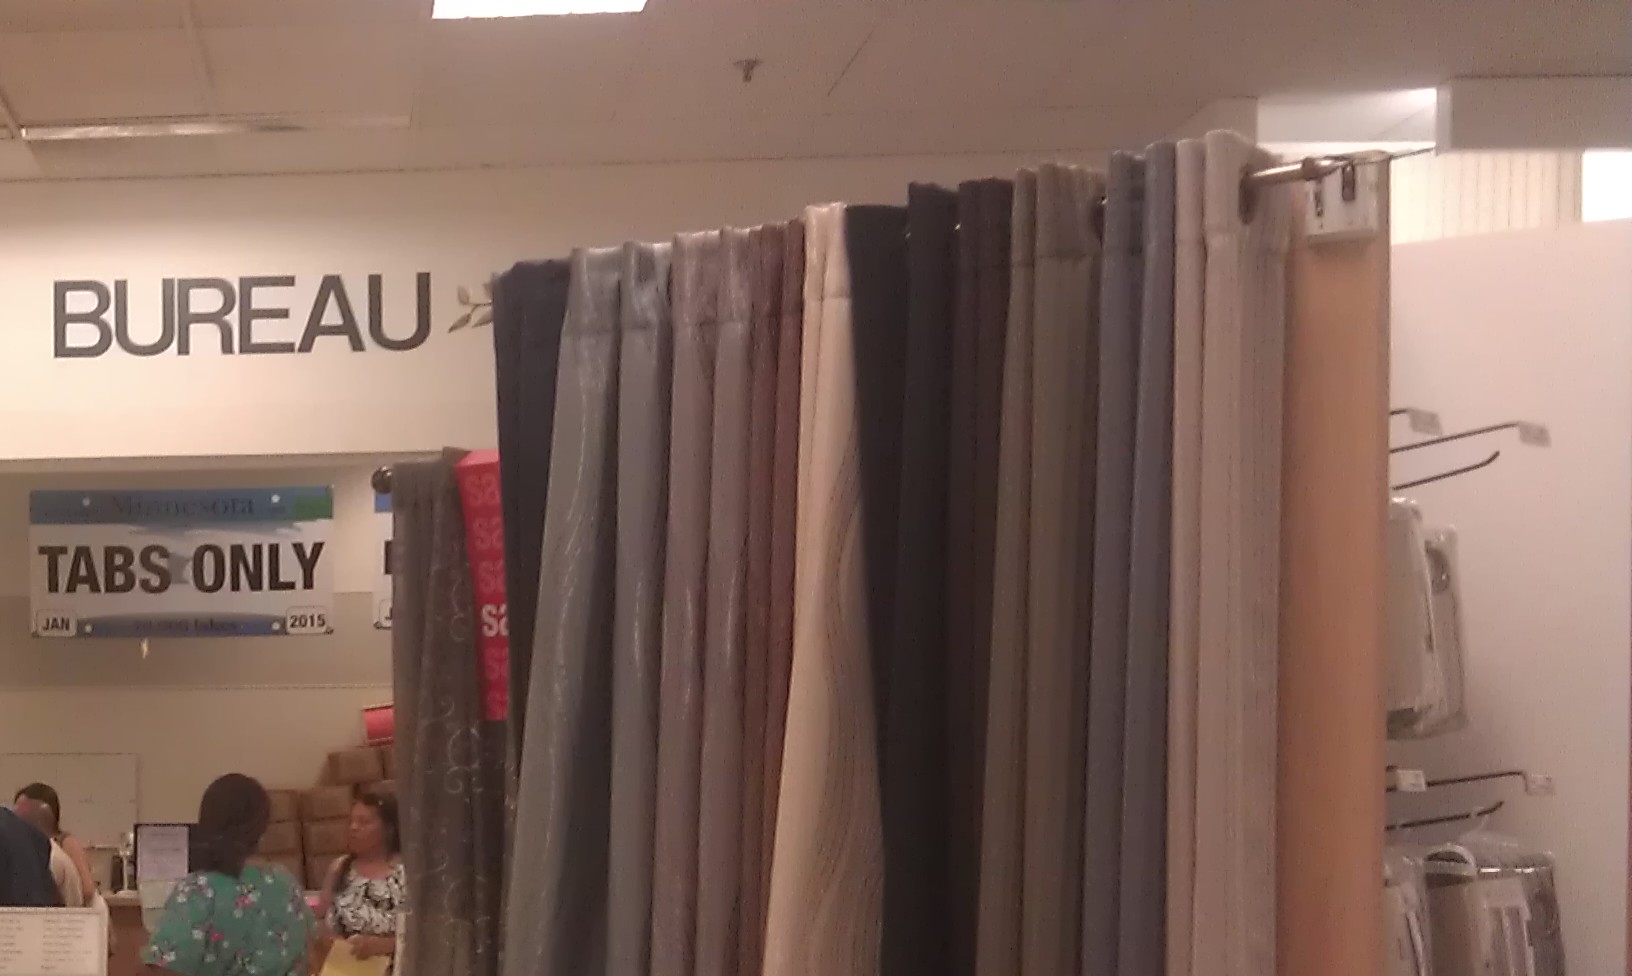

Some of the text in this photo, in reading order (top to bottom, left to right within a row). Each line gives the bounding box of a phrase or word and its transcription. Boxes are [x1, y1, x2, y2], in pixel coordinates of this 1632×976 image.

[53, 271, 432, 359] BUREAU
[38, 544, 172, 594] TABS
[192, 541, 325, 593] ONLY
[42, 617, 70, 632] JAN
[289, 612, 326, 629] 2015
